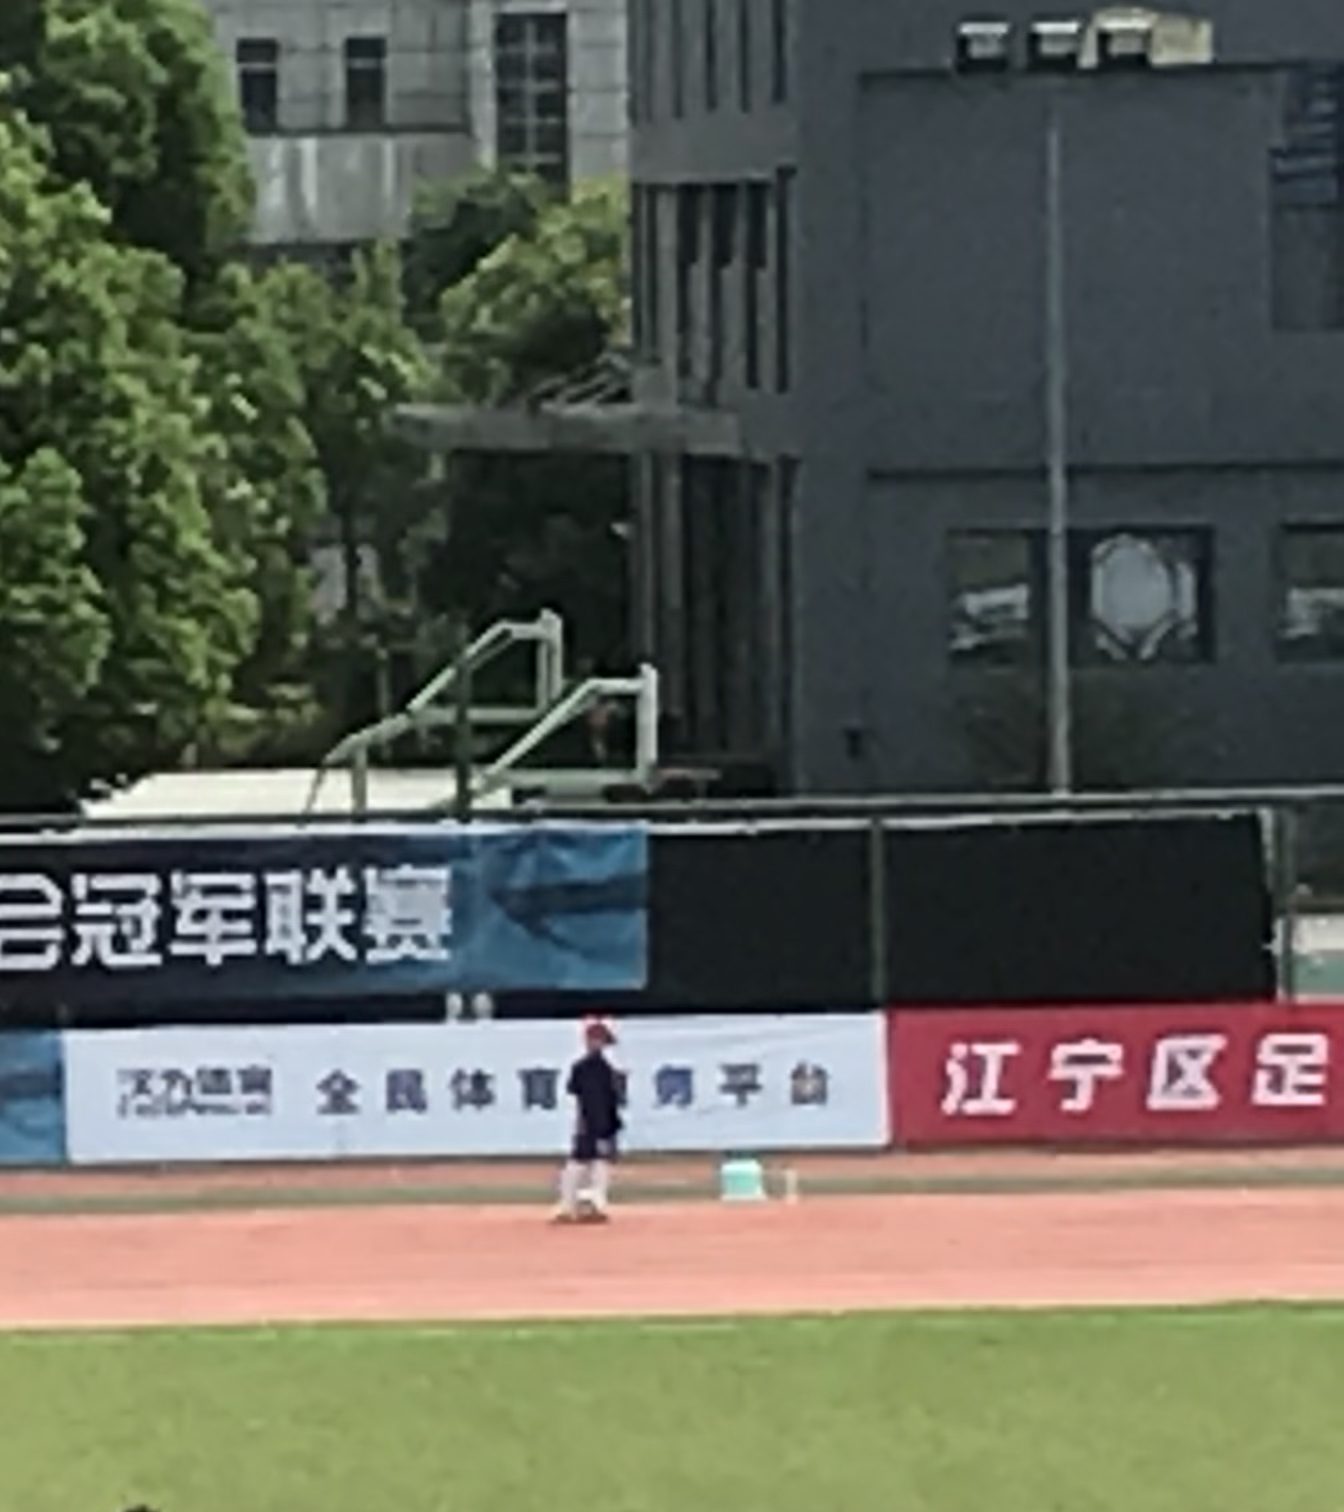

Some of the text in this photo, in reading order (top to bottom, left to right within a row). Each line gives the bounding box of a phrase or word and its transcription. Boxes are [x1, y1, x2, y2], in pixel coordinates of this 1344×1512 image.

[315, 1061, 831, 1116] 全民体育务平台
[941, 1033, 1330, 1115] 江宁区足
